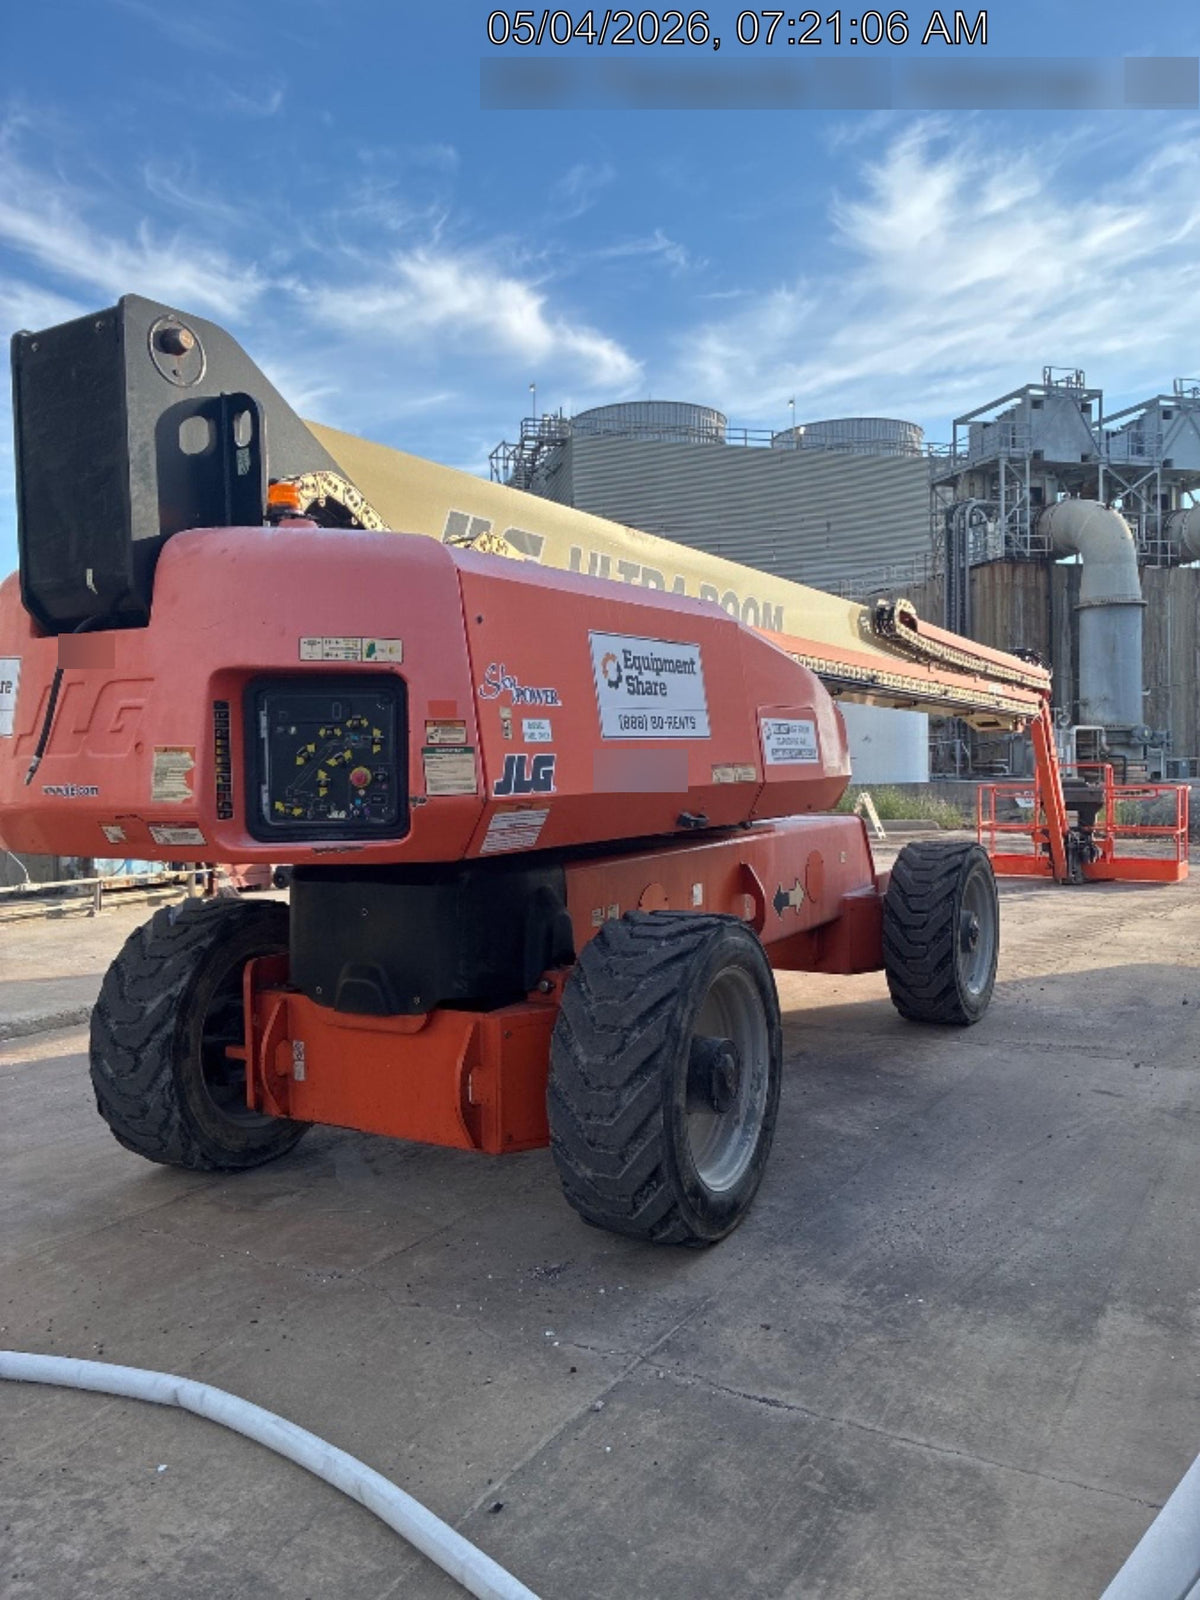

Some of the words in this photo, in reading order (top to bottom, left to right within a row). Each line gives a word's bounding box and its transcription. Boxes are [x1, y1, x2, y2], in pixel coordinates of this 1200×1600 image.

[622, 649, 697, 676] Equipment
[625, 675, 668, 697] Share
[618, 714, 648, 732] (888)
[493, 754, 557, 797] JLG
